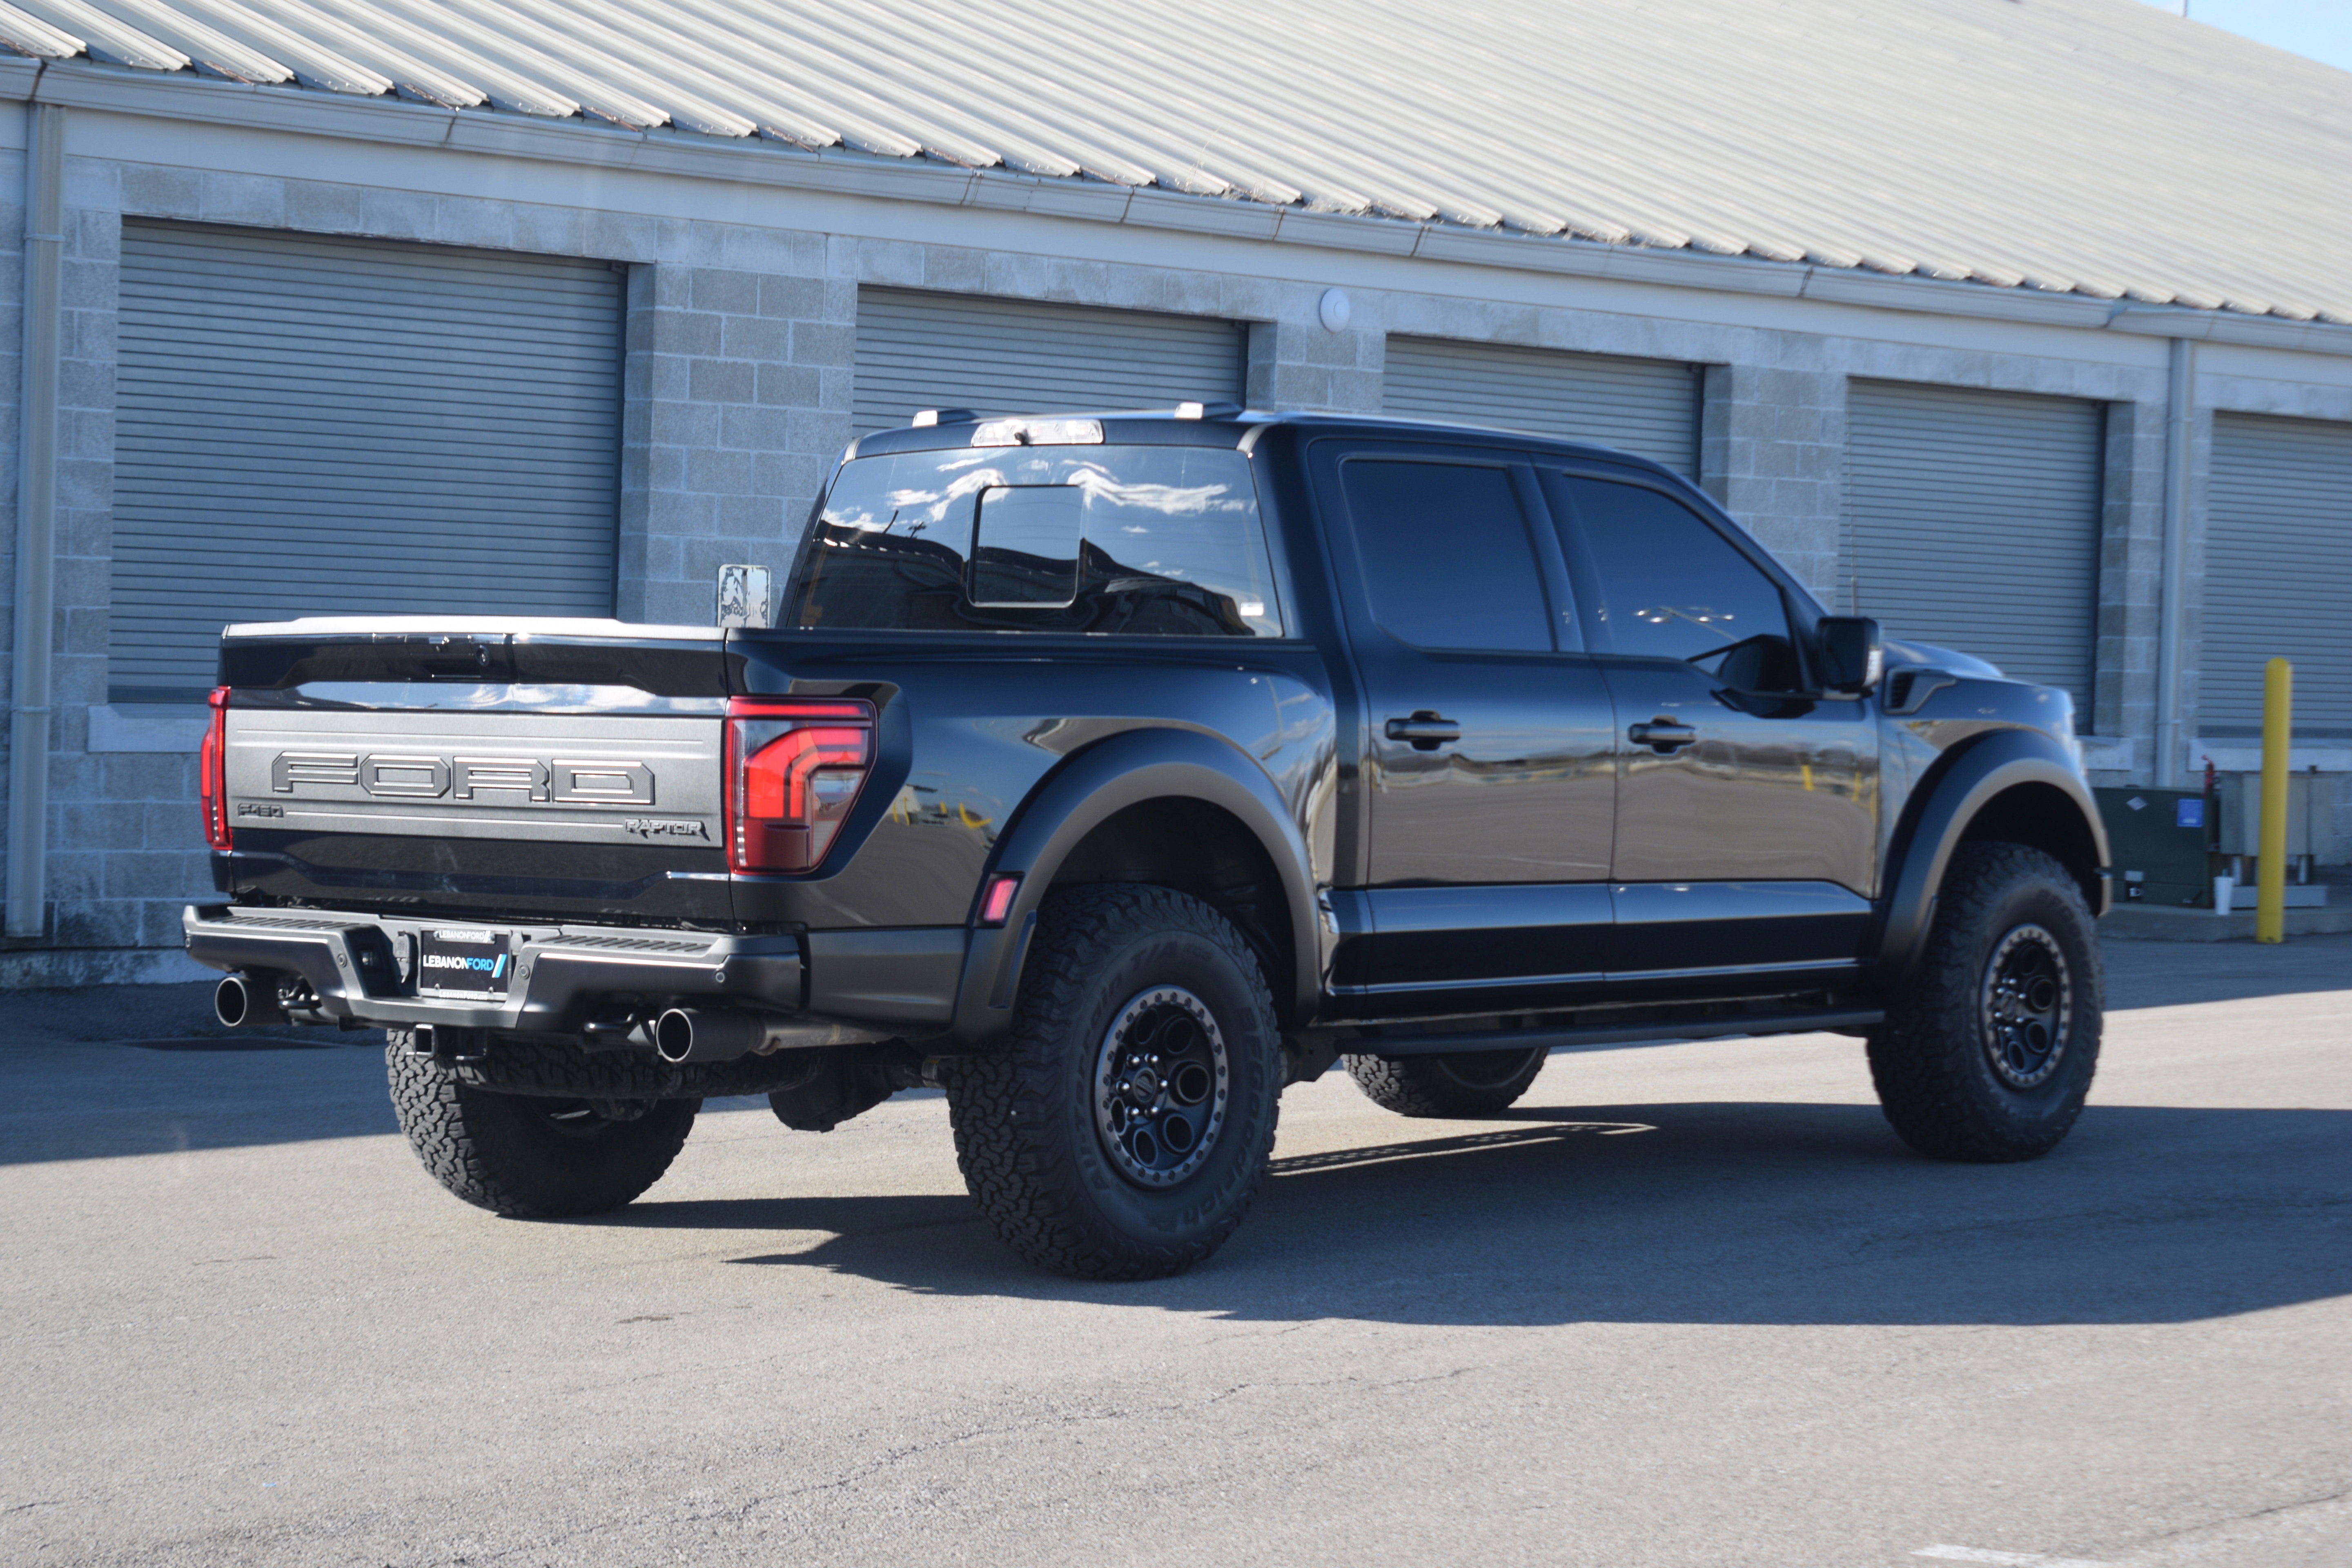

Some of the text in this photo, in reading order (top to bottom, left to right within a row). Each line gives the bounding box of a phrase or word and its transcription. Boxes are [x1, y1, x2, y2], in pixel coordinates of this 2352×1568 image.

[271, 750, 655, 806] FORD
[625, 818, 710, 842] RAPTOR
[423, 955, 494, 971] LEBANONFORD
